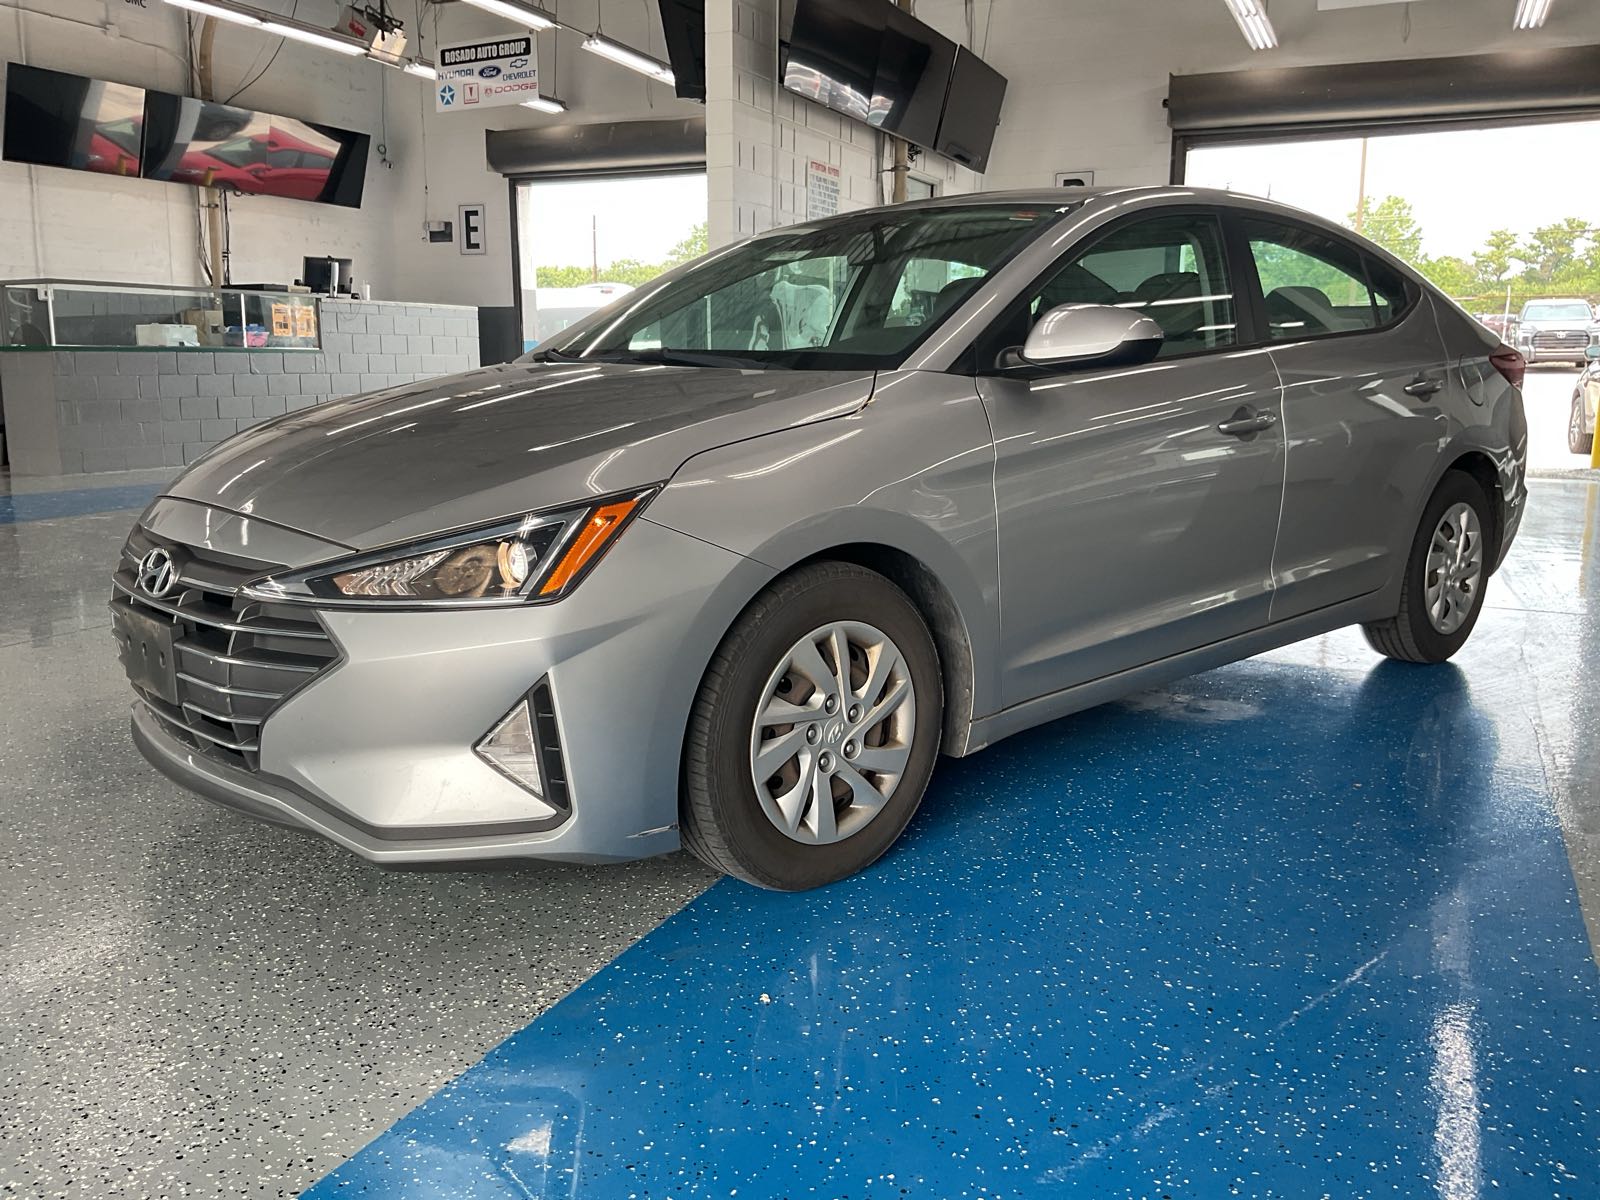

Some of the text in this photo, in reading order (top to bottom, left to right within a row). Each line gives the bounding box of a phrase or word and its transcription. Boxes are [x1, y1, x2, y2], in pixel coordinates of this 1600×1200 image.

[445, 41, 526, 63] ROSADO AUTO GROUP
[438, 68, 474, 80] HYUNDAI
[502, 69, 536, 81] CHEVROLET
[494, 82, 537, 93] DODGE
[464, 210, 480, 249] E
